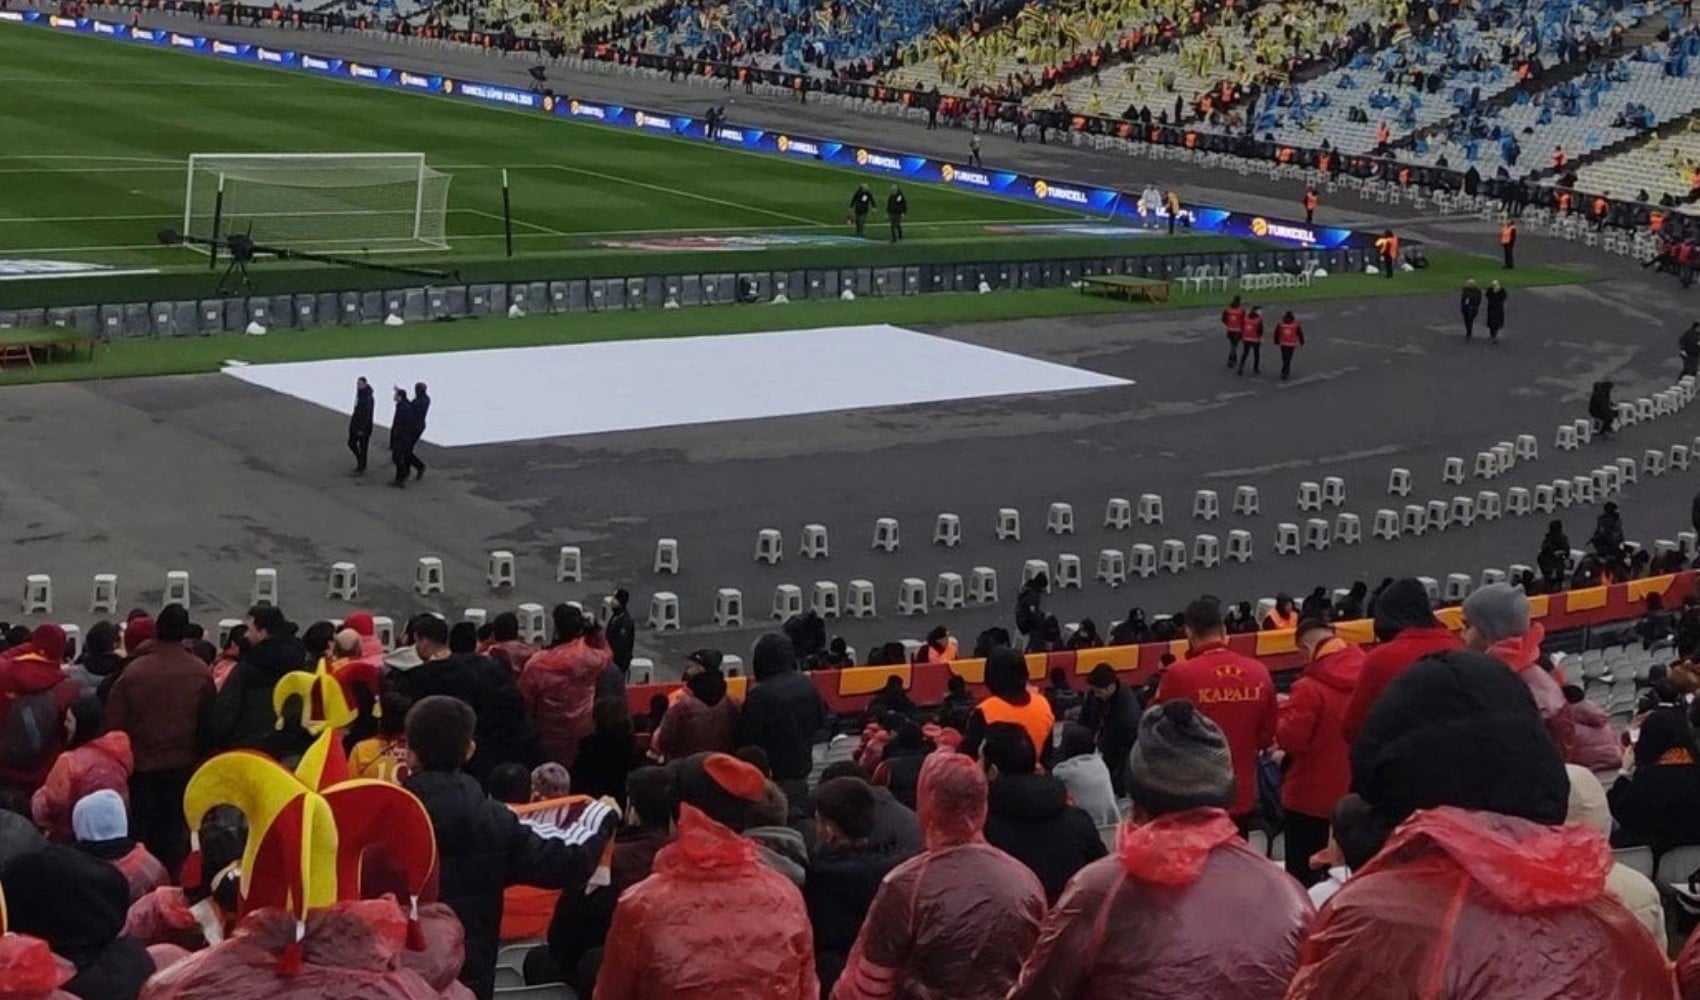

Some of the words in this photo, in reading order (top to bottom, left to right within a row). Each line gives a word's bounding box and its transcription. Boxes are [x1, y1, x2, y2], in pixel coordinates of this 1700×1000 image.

[788, 140, 819, 155] TURKCELL
[867, 153, 902, 170] TURKCELL
[953, 169, 990, 186] TURKCELL
[1047, 186, 1088, 203] TURKCELL
[1267, 223, 1317, 243] TURKCELL
[1198, 685, 1262, 703] KAPALI
